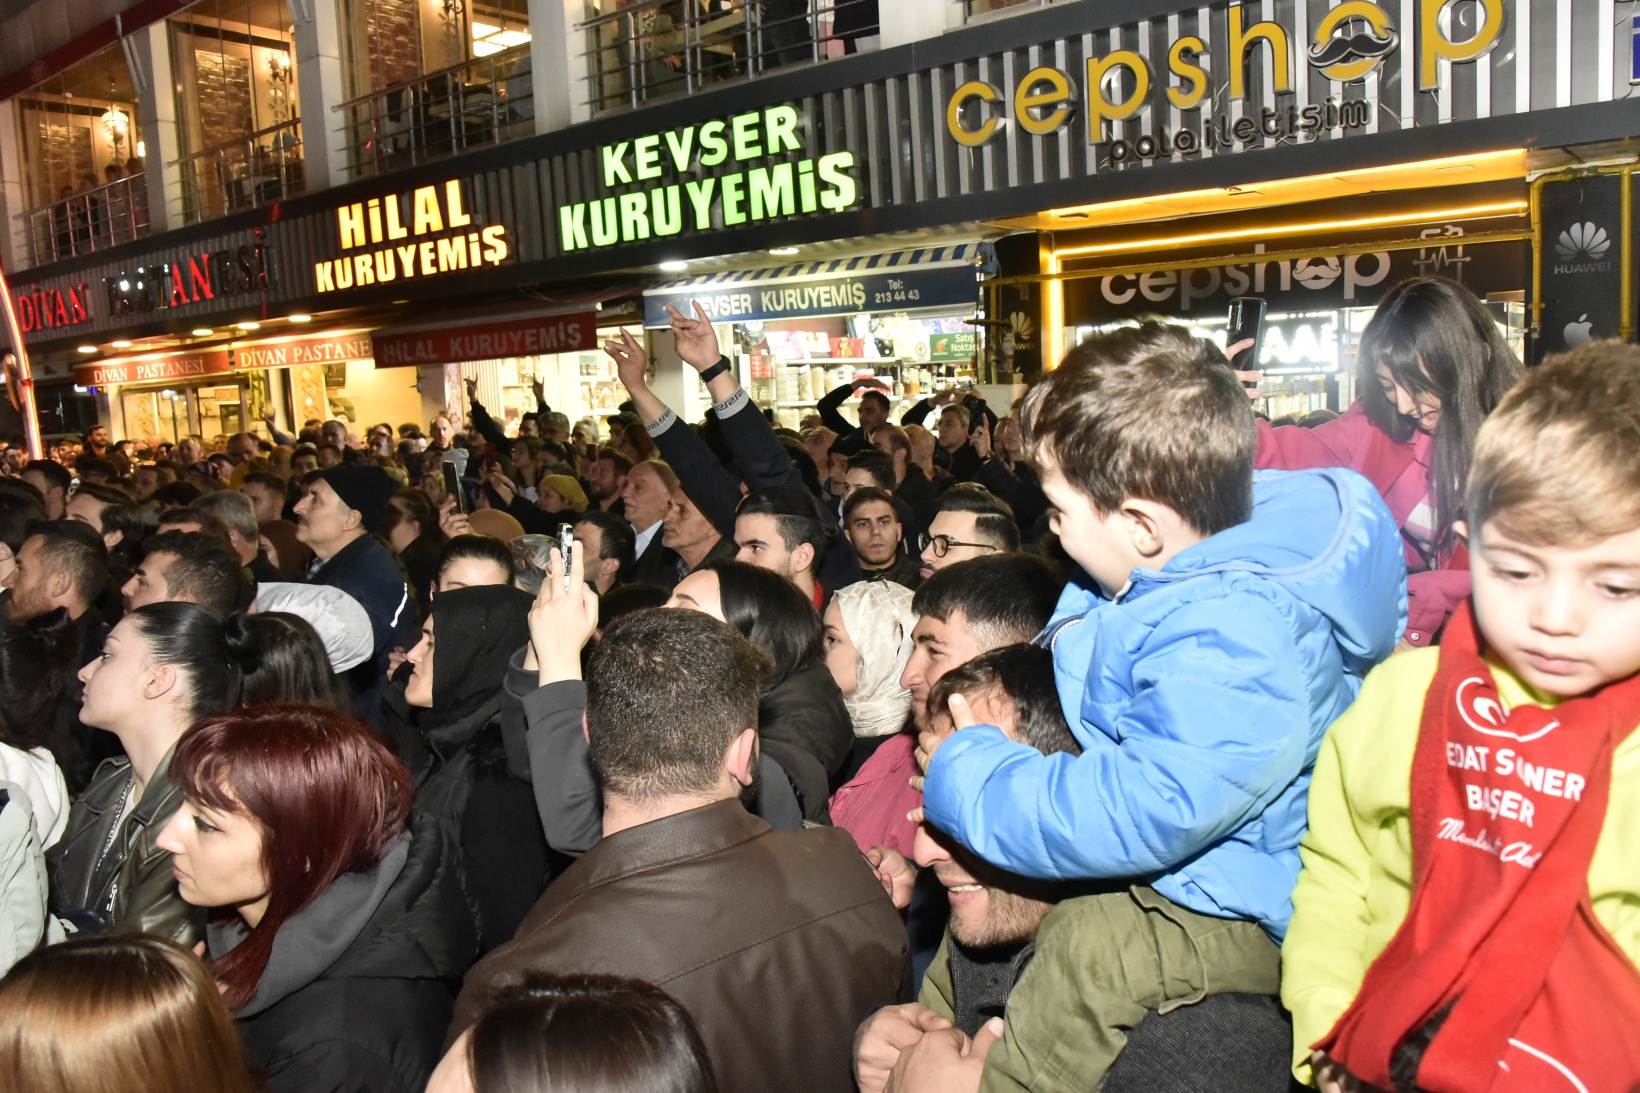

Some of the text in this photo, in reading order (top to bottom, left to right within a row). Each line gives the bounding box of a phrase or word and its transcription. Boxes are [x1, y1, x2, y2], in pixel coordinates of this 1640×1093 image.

[947, 0, 1503, 147] cepshop
[602, 105, 801, 187] KEVSER
[1554, 261, 1611, 275] HUAWEI
[761, 278, 867, 312] KURUYEMİŞ
[875, 289, 920, 304] 213 44 43
[887, 279, 904, 291] Tel:
[18, 282, 93, 333] DİVAN
[239, 339, 371, 369] DİVAN PASTANE
[382, 322, 582, 363] HİLAL KURUYEMİŞ
[93, 356, 206, 384] DİVAN PASTANESİ
